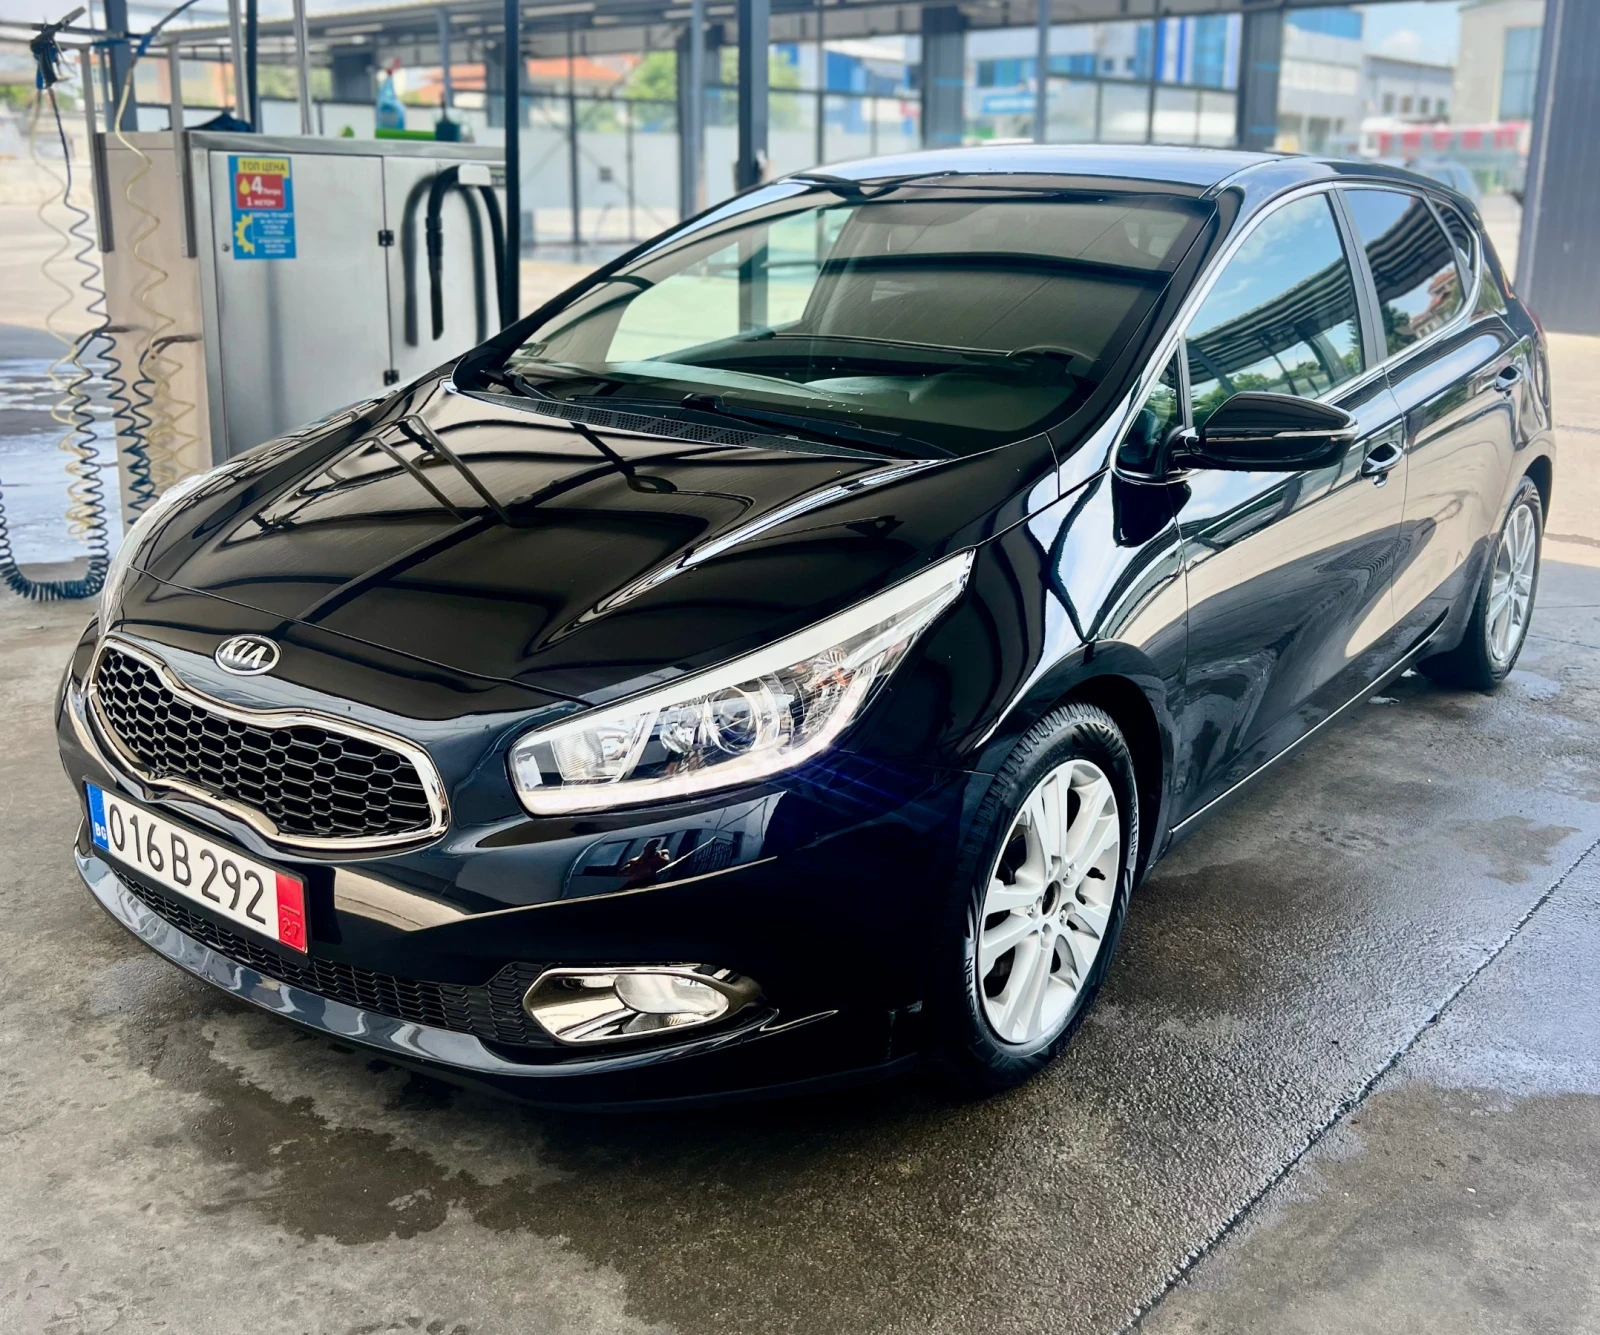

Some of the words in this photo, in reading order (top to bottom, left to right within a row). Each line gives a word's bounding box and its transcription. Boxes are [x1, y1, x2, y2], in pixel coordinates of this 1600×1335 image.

[241, 161, 259, 171] ТОП
[262, 161, 286, 173] ЦЕНА
[251, 175, 263, 195] 4
[246, 196, 252, 206] 1
[220, 638, 268, 669] KIA
[95, 822, 107, 841] BG
[281, 918, 300, 940] 27
